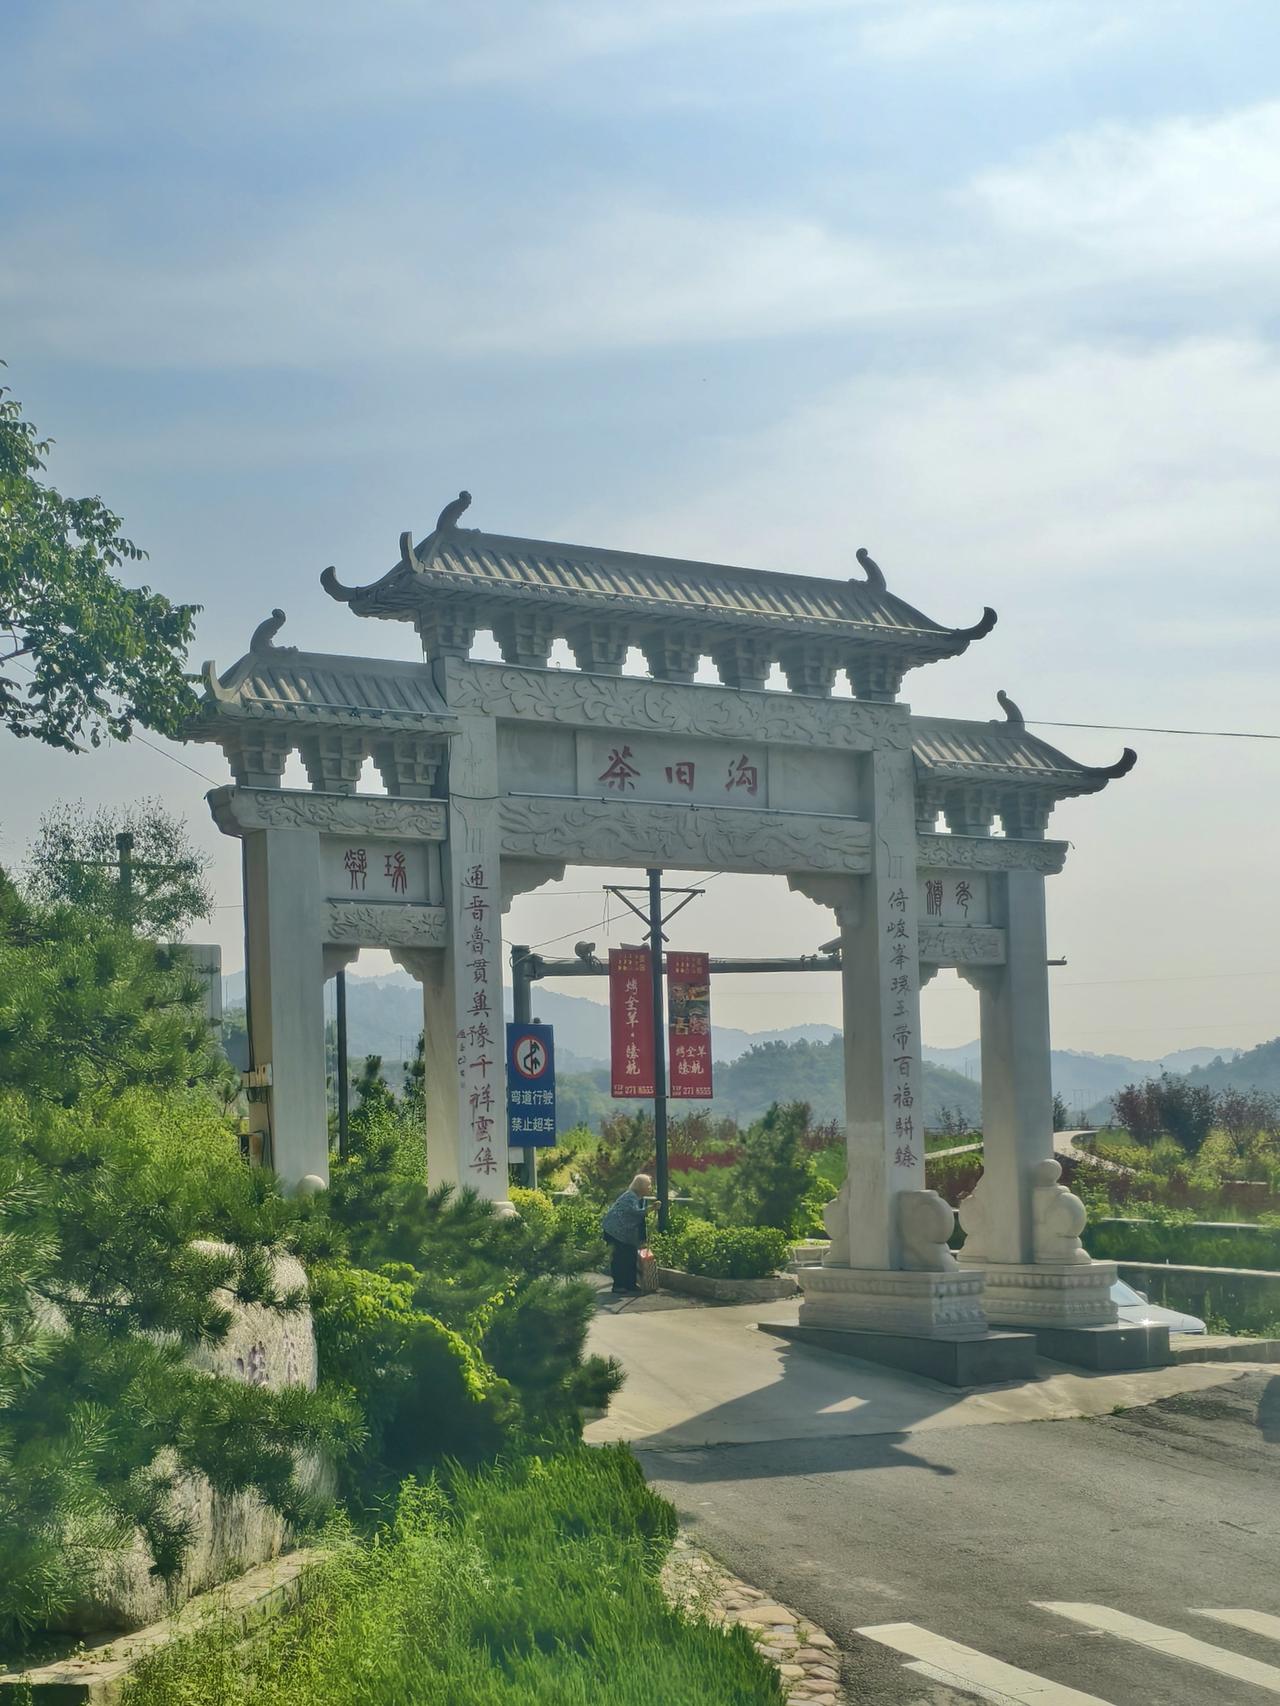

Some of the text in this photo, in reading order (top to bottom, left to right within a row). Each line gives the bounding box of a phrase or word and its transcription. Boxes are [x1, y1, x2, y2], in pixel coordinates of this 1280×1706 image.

[511, 1089, 554, 1106] 弯道行驶
[511, 1116, 555, 1132] 禁止超车
